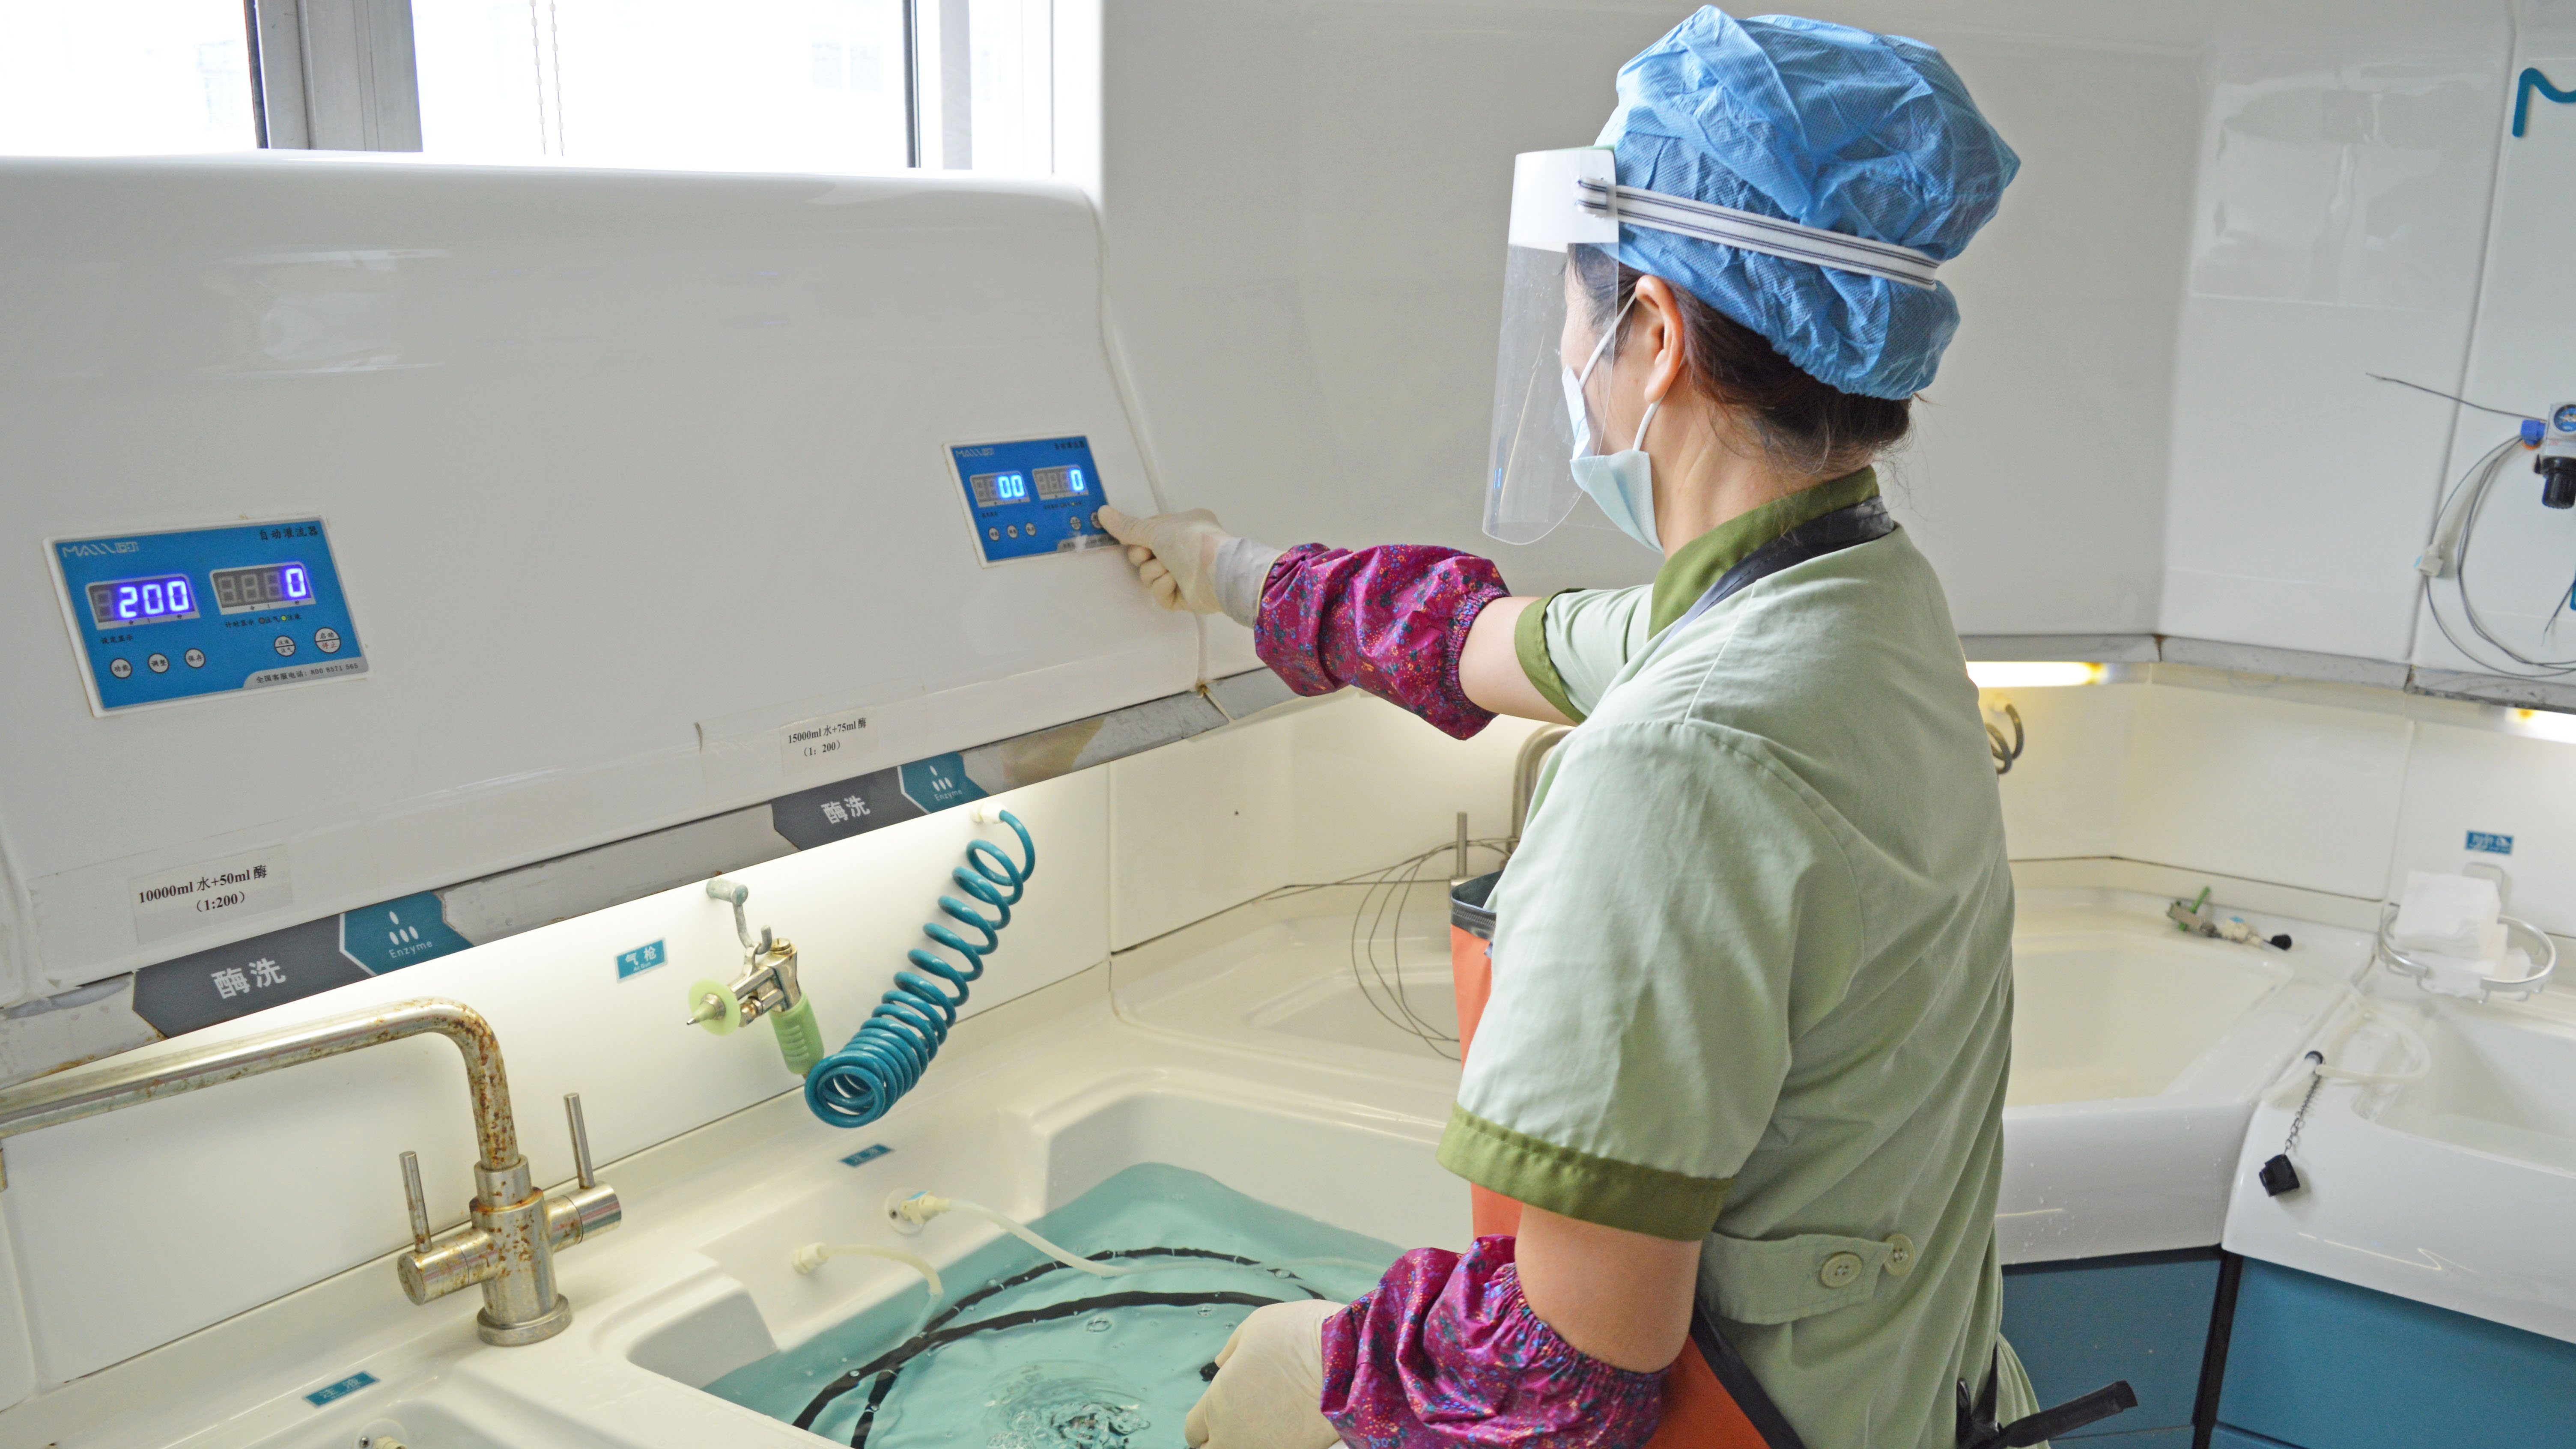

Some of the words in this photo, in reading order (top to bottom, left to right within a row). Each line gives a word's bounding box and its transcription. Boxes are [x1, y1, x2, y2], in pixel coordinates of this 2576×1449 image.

[1070, 469, 1084, 491] 0
[259, 526, 318, 540] 自动灌流器
[285, 568, 306, 597] 0
[119, 580, 189, 618] 200
[788, 728, 821, 743] 15000ml
[934, 789, 963, 802] Enzyme
[821, 795, 871, 824] 酶洗
[139, 882, 193, 903] 10000ml
[253, 865, 267, 880] 酶
[388, 939, 433, 959] Enzyme
[625, 946, 656, 966] 气枪
[211, 958, 286, 999] 酶洗
